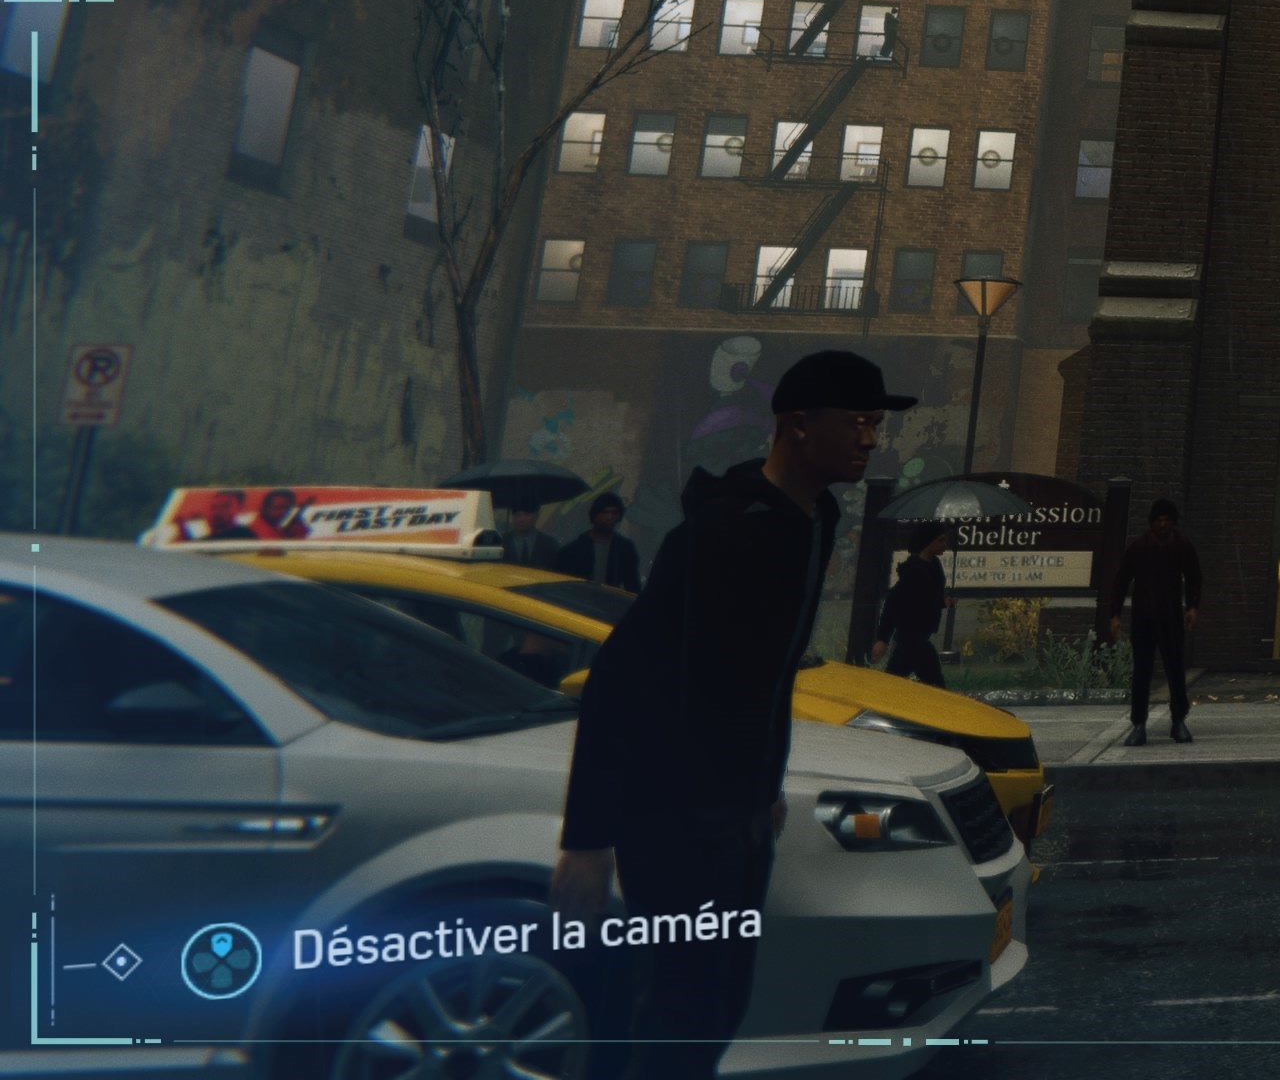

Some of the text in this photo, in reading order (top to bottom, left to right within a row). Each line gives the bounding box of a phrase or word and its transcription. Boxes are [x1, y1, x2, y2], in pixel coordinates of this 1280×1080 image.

[336, 511, 460, 533] LAST DAY
[957, 524, 1042, 547] Shelter
[1000, 555, 1064, 568] SERVICE
